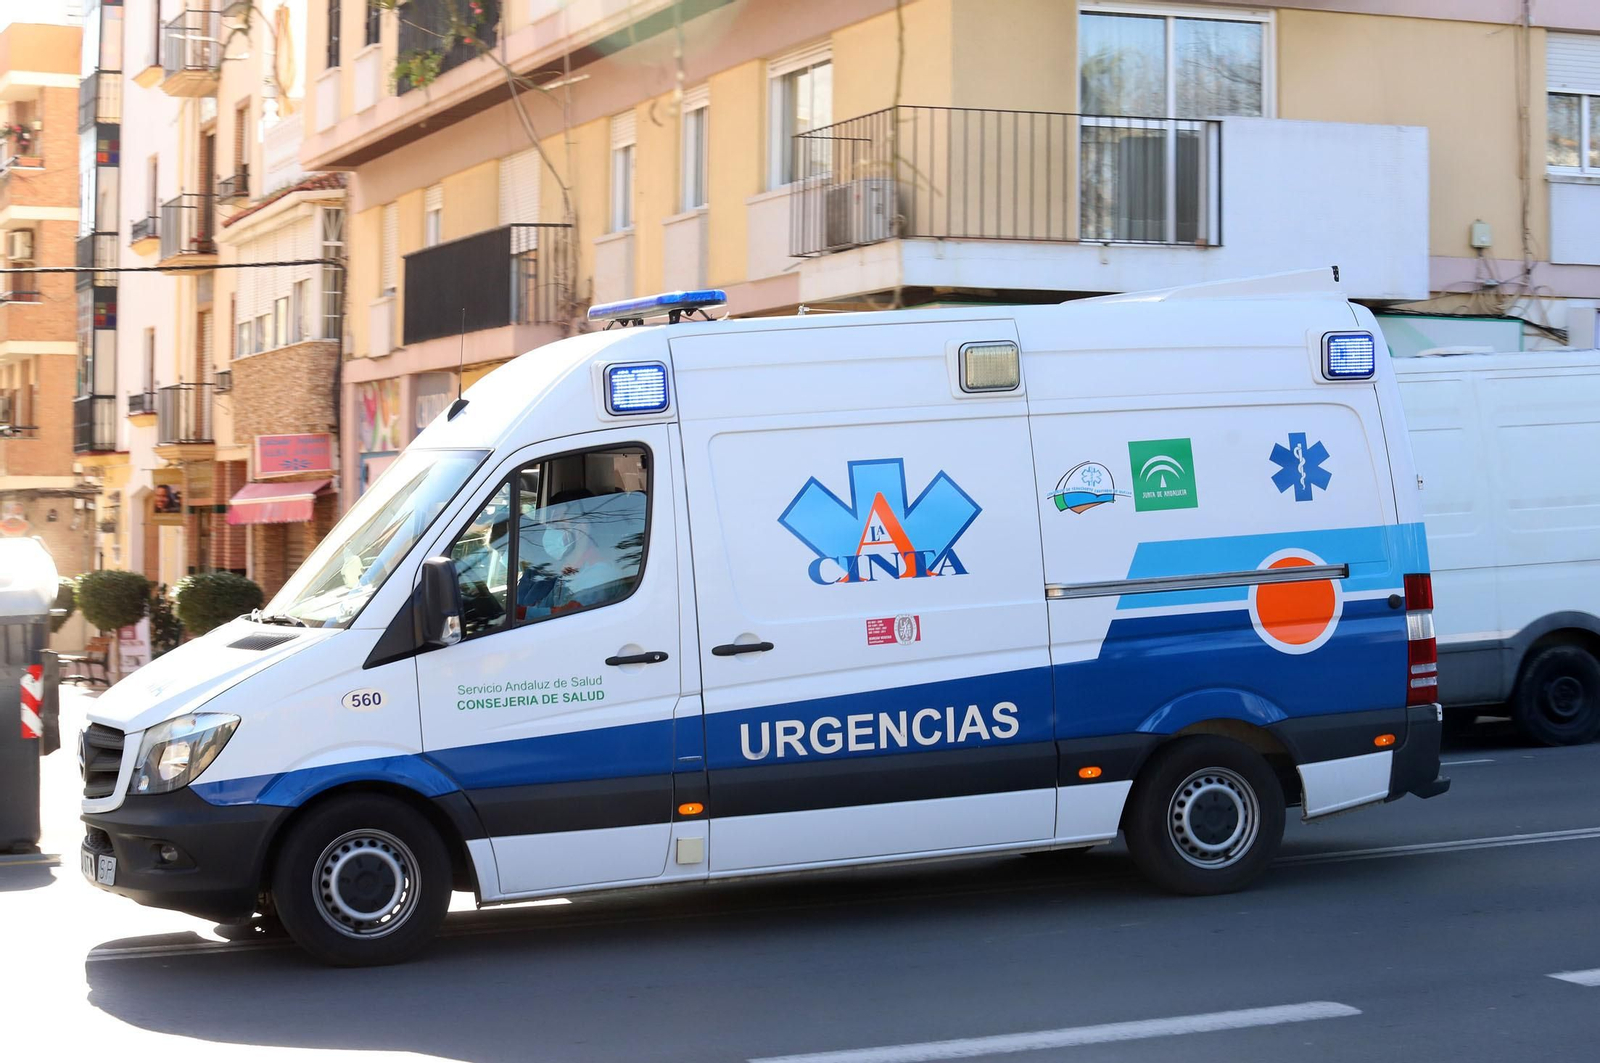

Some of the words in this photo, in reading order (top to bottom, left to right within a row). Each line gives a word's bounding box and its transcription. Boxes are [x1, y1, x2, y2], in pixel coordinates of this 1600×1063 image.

[870, 525, 885, 542] LA
[808, 548, 970, 585] CINTA
[457, 684, 503, 696] Servicio
[505, 679, 550, 692] Andaluz
[553, 678, 568, 689] de
[571, 675, 603, 687] Salud
[351, 692, 382, 708] 560
[457, 695, 539, 711] CONSEJERIA
[542, 693, 559, 705] DE
[562, 690, 605, 703] SALUD
[740, 701, 1020, 761] URGENCIAS
[100, 859, 113, 881] SP
